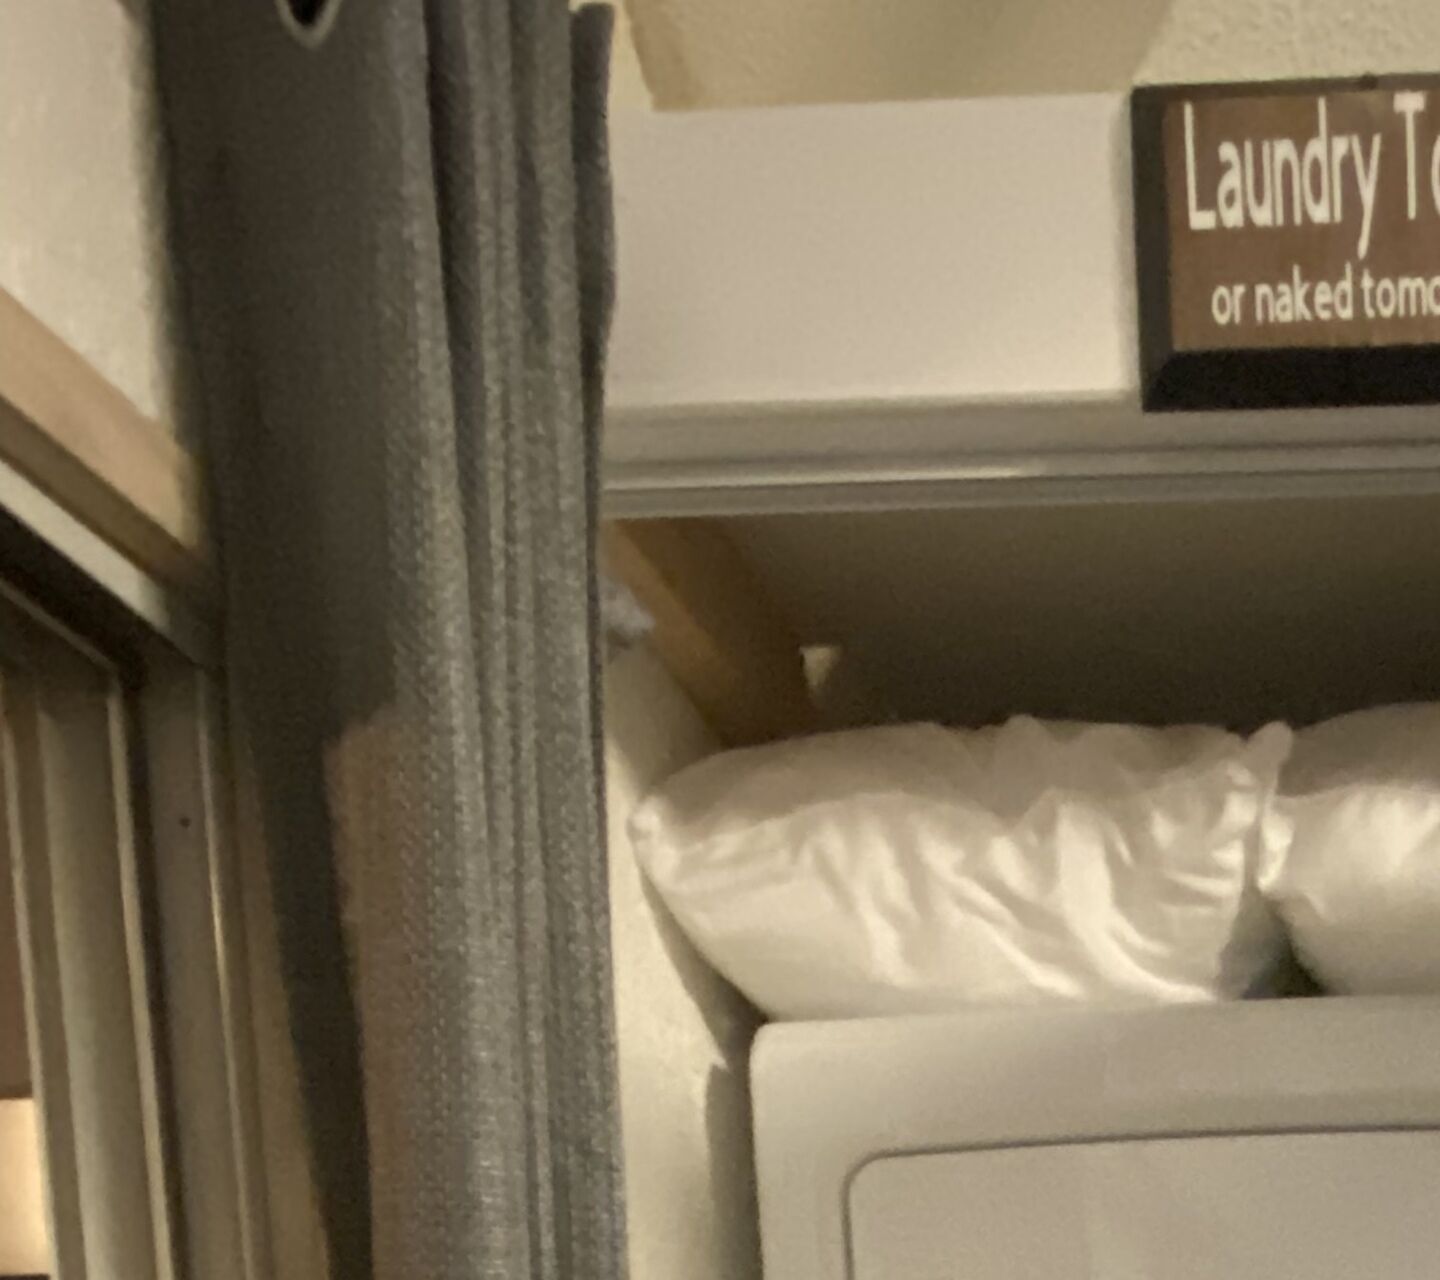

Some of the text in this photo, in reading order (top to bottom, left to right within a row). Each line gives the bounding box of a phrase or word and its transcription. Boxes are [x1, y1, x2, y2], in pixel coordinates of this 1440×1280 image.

[1183, 96, 1382, 260] Laundry
[1211, 283, 1242, 325] or
[1255, 263, 1353, 325] naked
